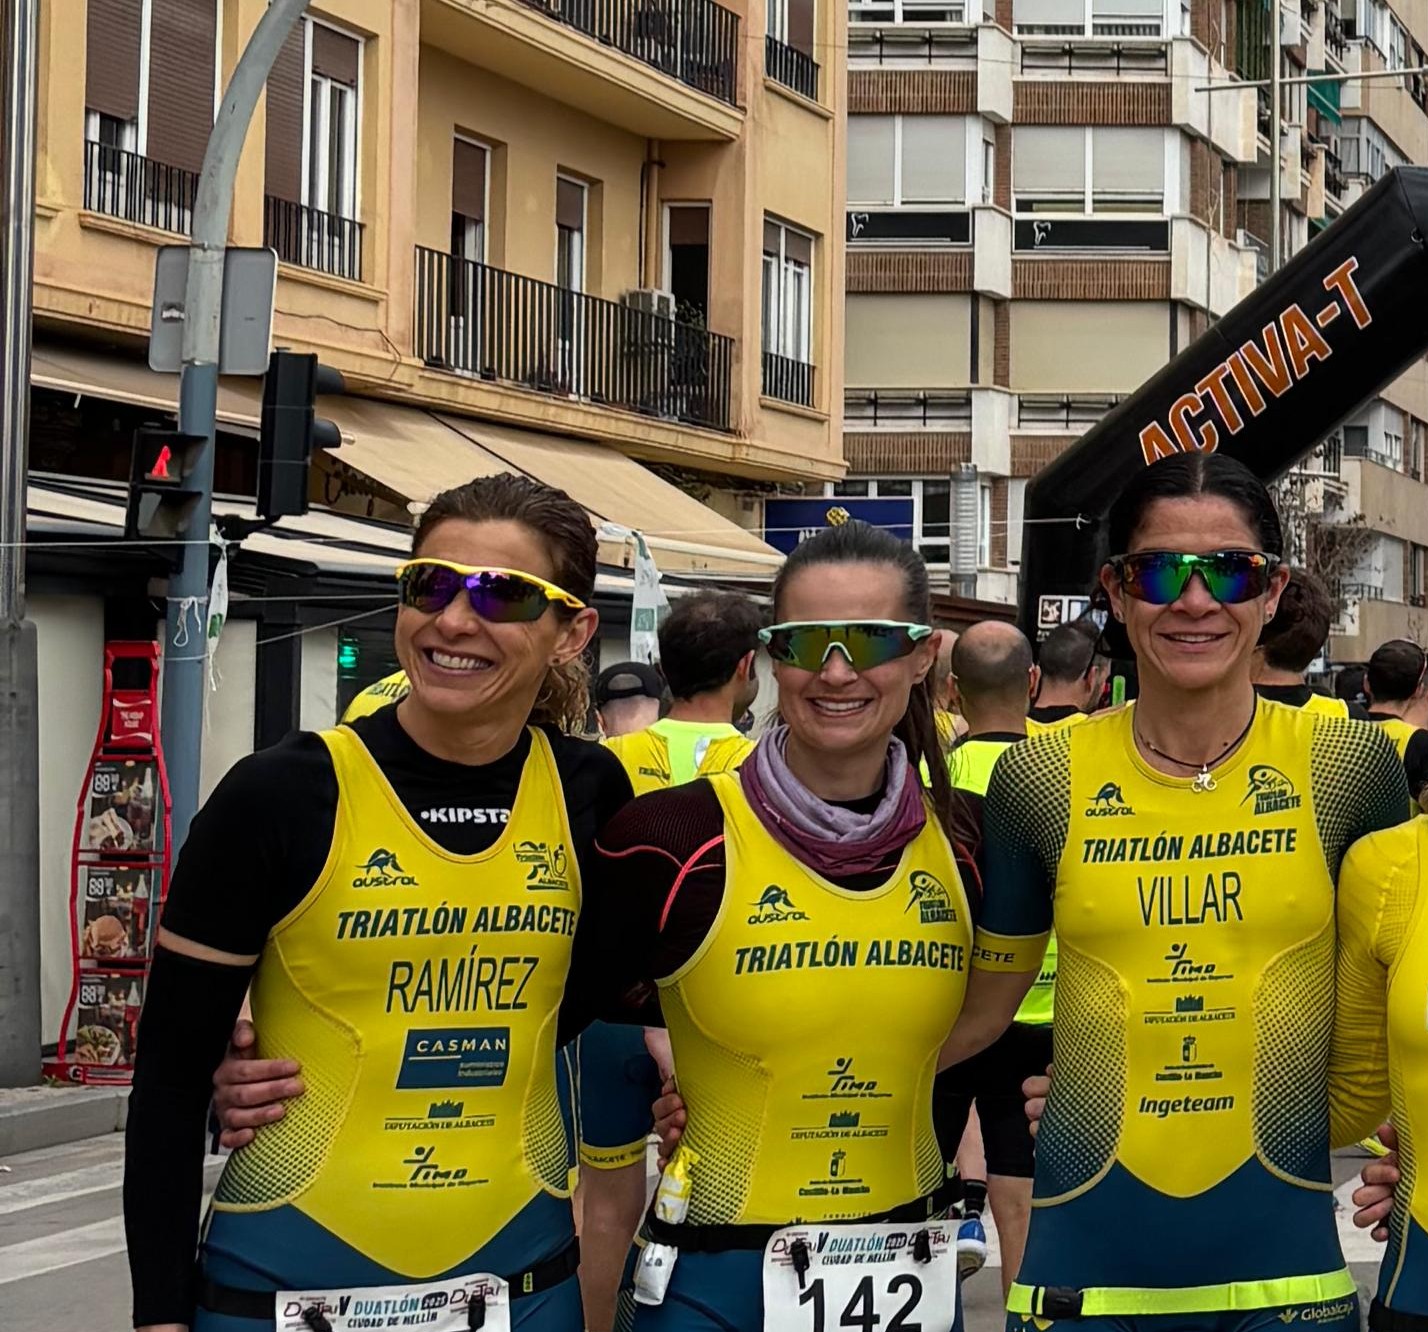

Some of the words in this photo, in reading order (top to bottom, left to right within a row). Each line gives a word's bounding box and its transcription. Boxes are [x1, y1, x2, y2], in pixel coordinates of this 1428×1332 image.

[1138, 256, 1372, 466] ACTIVA-T
[1083, 830, 1184, 864] TRIATLÓN
[1189, 828, 1297, 861] ALBACETE
[1137, 871, 1243, 926] VILLAR
[337, 902, 467, 940] TRIATLÓN
[472, 904, 575, 937] ALBACETE
[735, 935, 856, 974] TRIATLÓN
[866, 940, 963, 971] ALBACETE
[386, 945, 539, 1014] RAMÍREZ
[417, 1038, 507, 1054] CASMAN
[1139, 1095, 1234, 1119] Ingeteam
[829, 1231, 883, 1253] DUATLÓN
[354, 1292, 420, 1316] DUATLÓN
